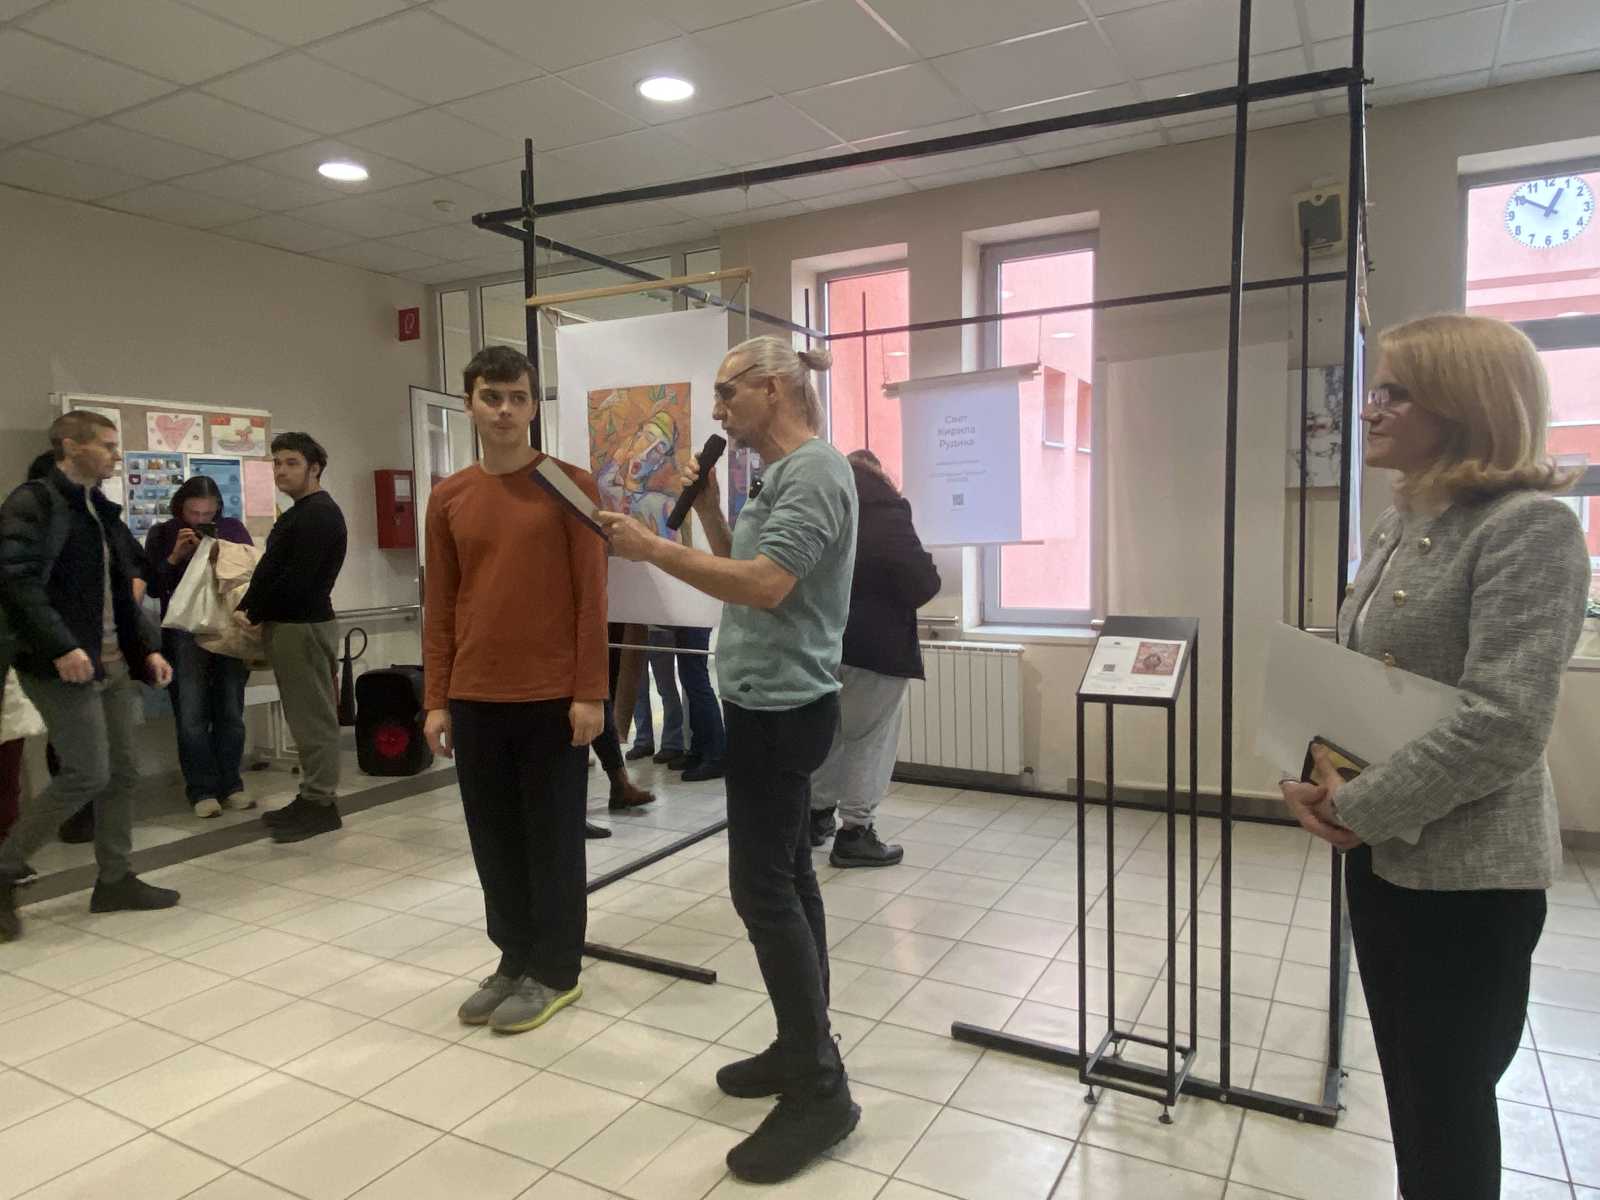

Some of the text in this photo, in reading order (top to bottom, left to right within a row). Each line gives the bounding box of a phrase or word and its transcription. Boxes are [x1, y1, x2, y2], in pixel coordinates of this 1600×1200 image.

[1528, 183, 1538, 193] 11
[1577, 186, 1583, 196] 2
[1584, 202, 1590, 212] 3
[1509, 211, 1515, 221] 9
[1577, 217, 1583, 225] 4
[1515, 226, 1521, 235] 8
[1563, 229, 1569, 239] 5
[1528, 234, 1535, 244] 7
[1545, 236, 1551, 245] 6
